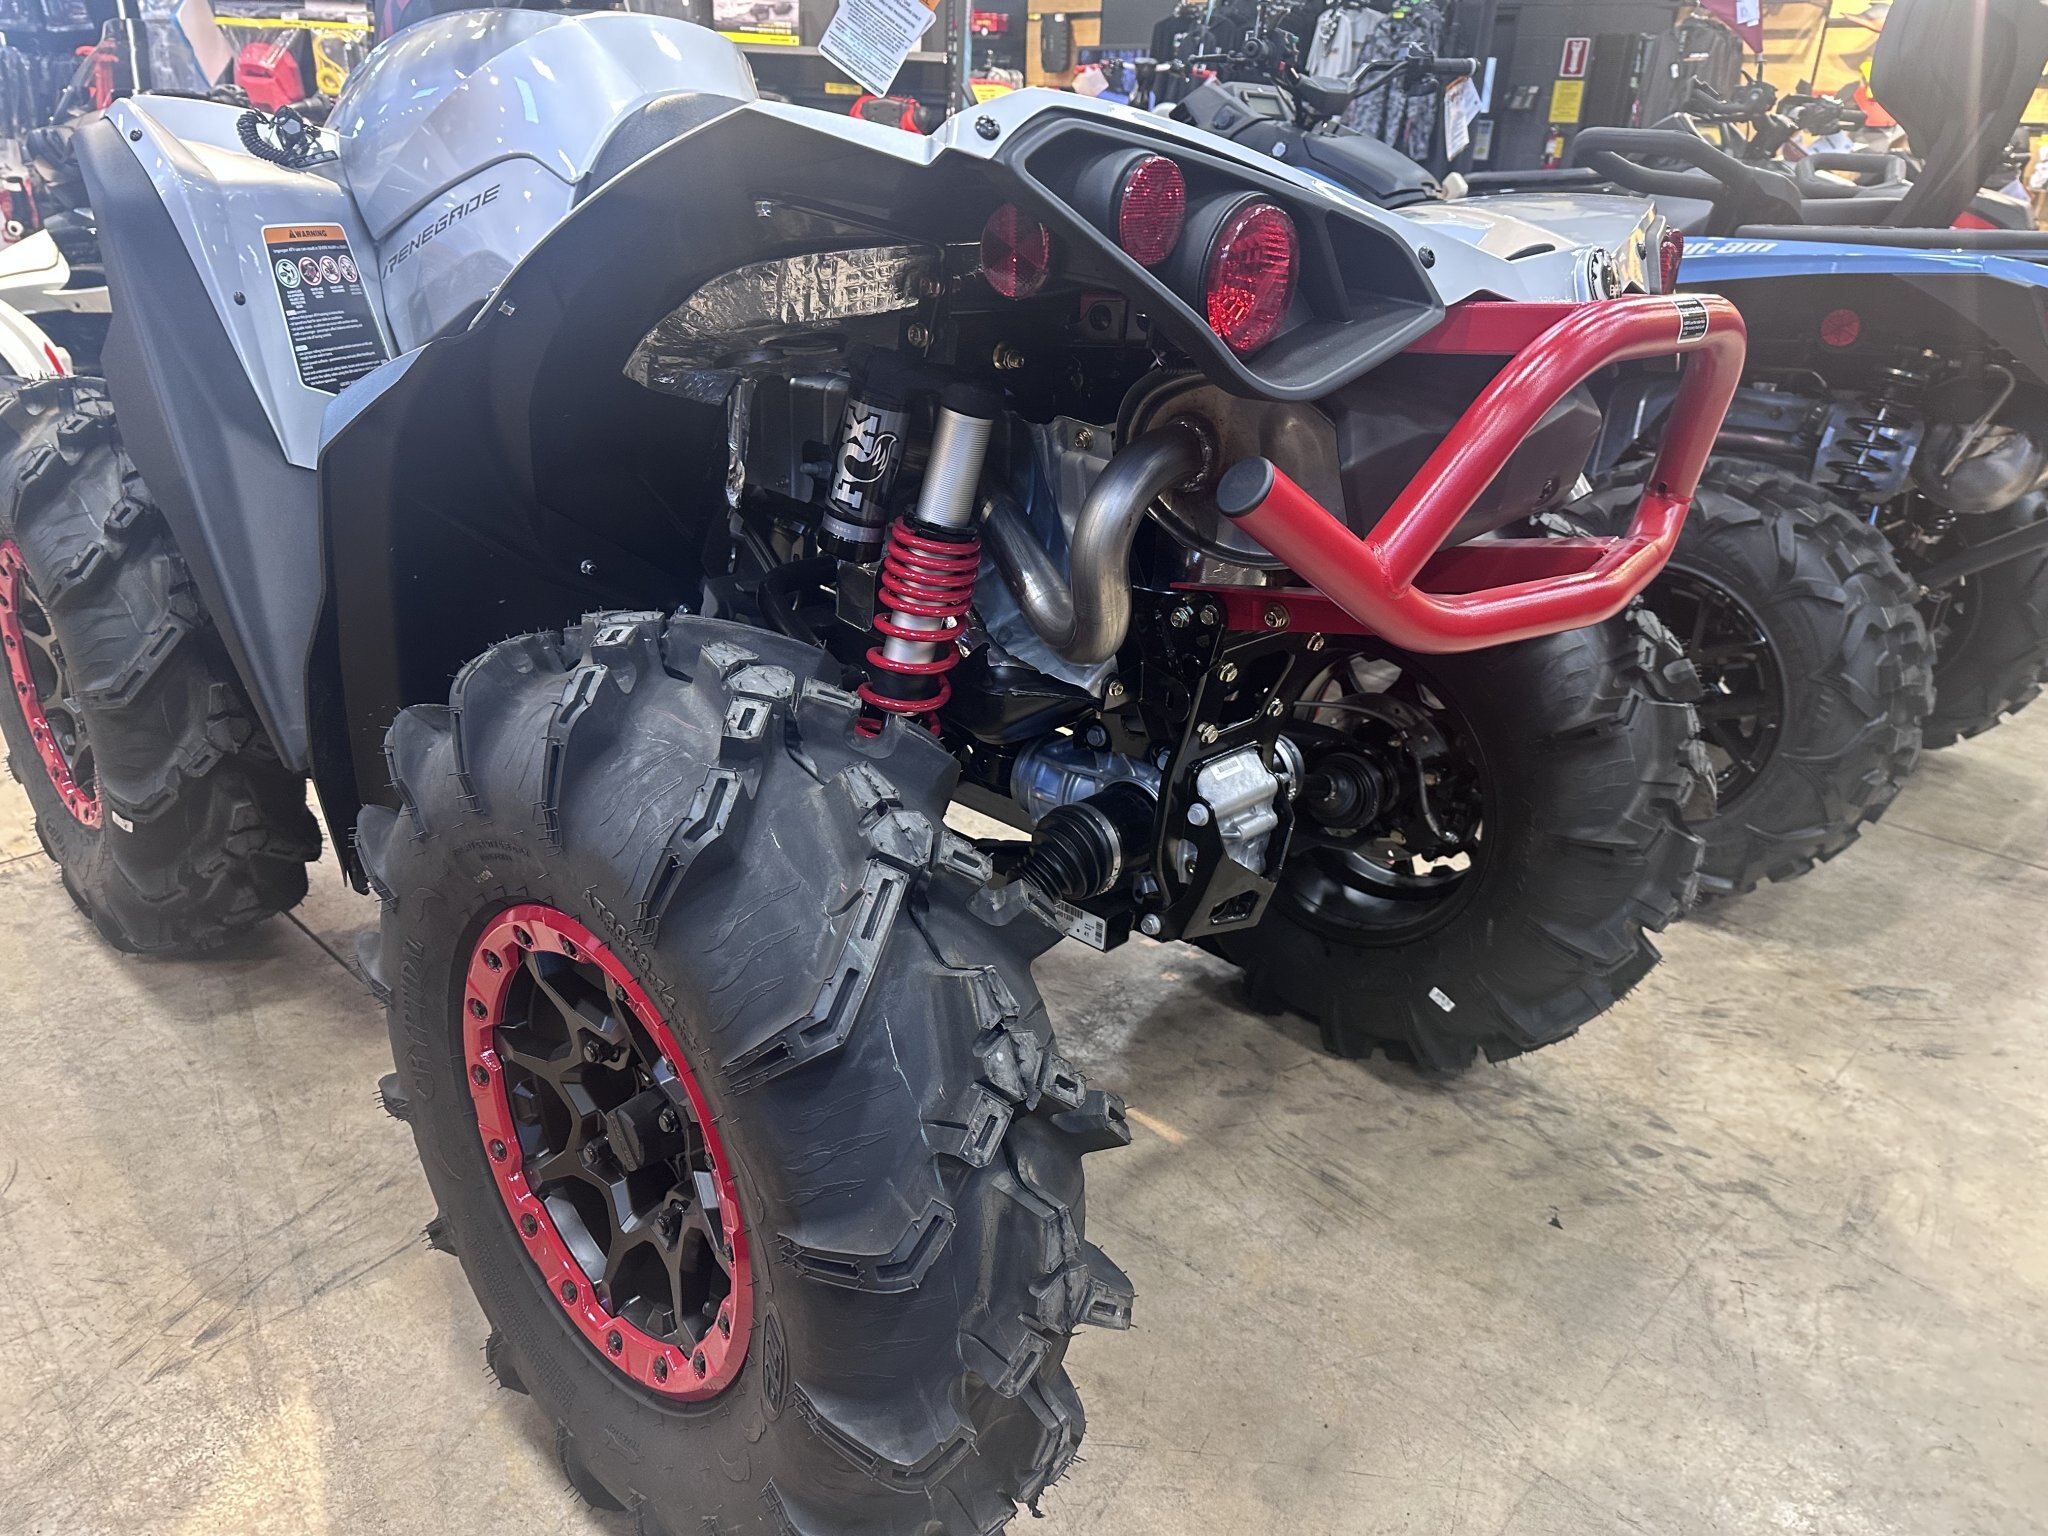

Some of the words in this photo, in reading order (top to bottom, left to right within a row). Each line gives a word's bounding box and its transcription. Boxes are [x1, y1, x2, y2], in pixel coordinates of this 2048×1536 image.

[295, 230, 328, 239] WARNING
[383, 184, 501, 279] RENEGADE
[831, 404, 892, 510] FOX
